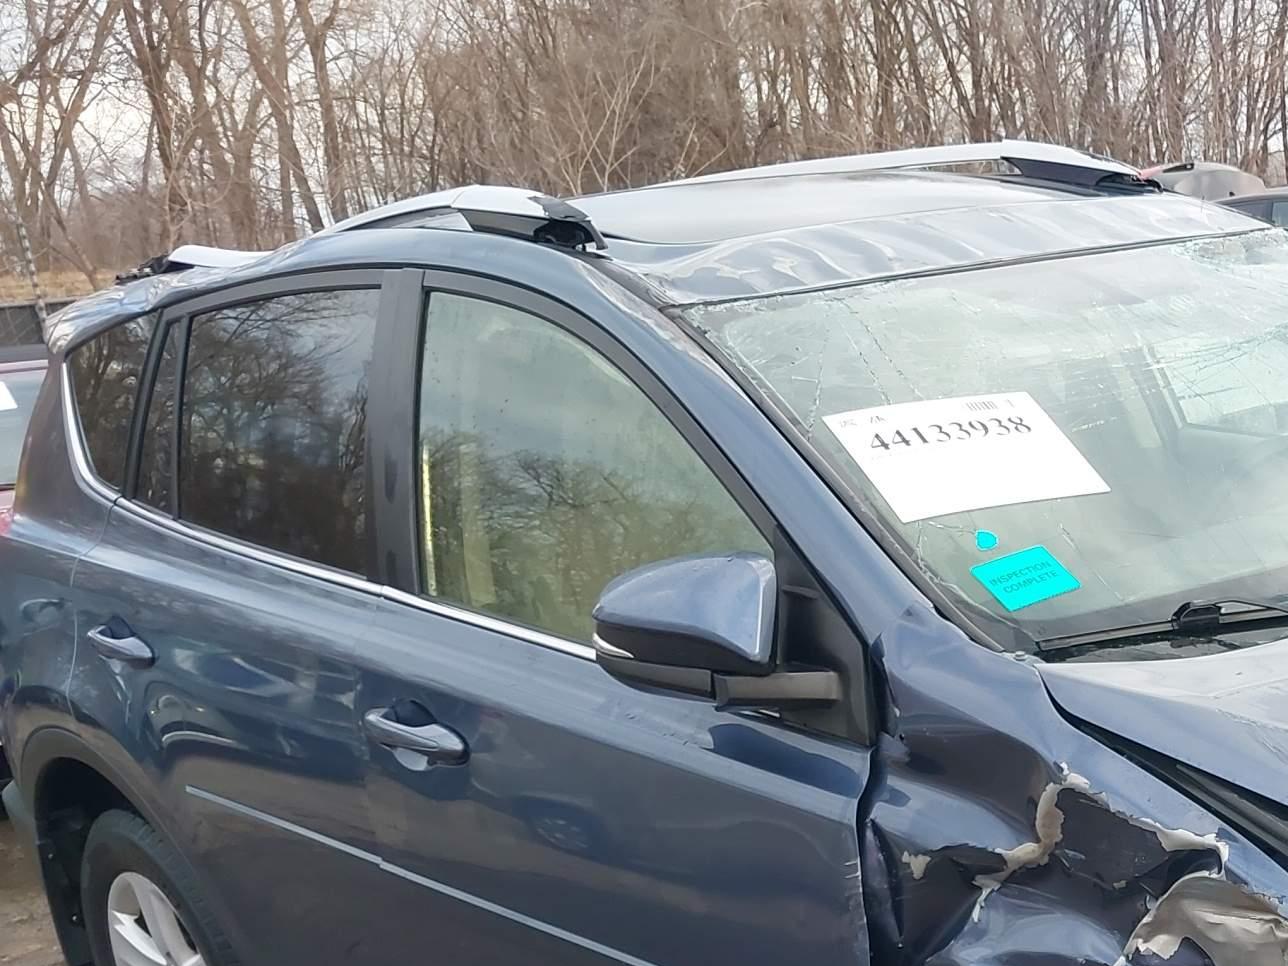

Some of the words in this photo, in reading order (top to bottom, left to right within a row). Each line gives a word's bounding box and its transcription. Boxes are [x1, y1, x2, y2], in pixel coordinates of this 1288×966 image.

[870, 415, 1032, 450] 44133938
[989, 560, 1052, 587] INSPECTION
[1003, 569, 1058, 594] COMPLETE
